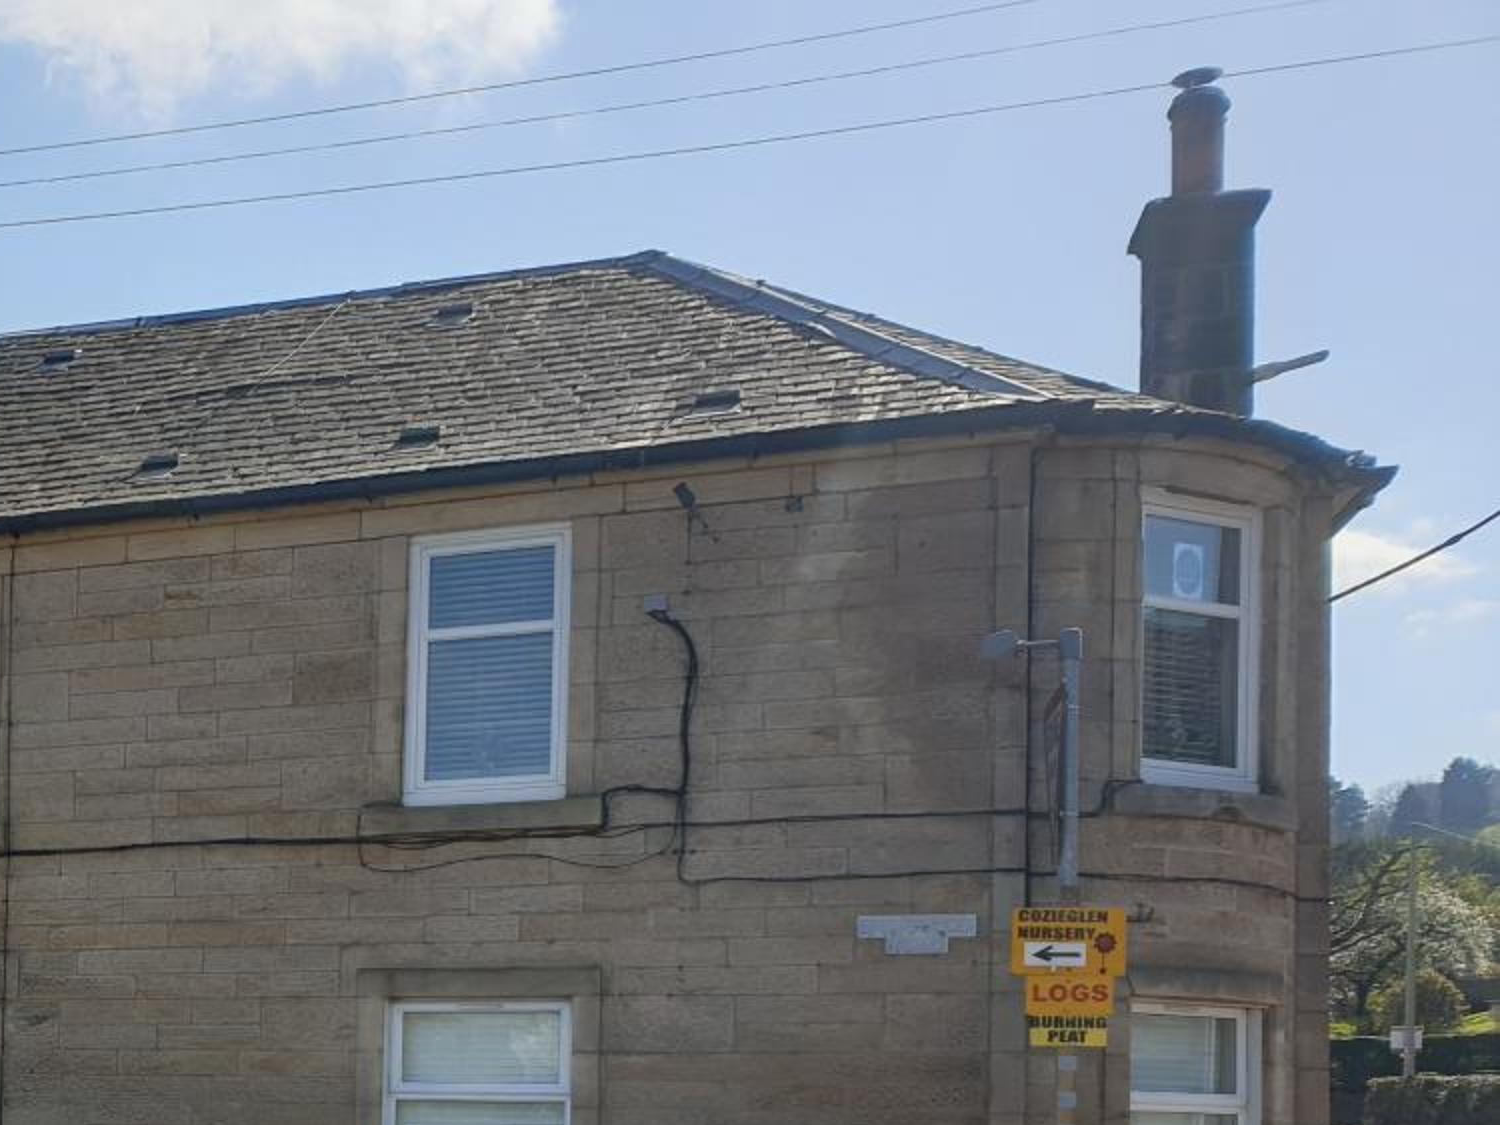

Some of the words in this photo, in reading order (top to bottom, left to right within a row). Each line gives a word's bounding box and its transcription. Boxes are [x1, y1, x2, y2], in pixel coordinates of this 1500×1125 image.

[1017, 926, 1096, 939] NURSERY
[1033, 984, 1108, 1002] LOGS
[1028, 1015, 1107, 1028] BURNING
[1047, 1029, 1087, 1042] PEAT
